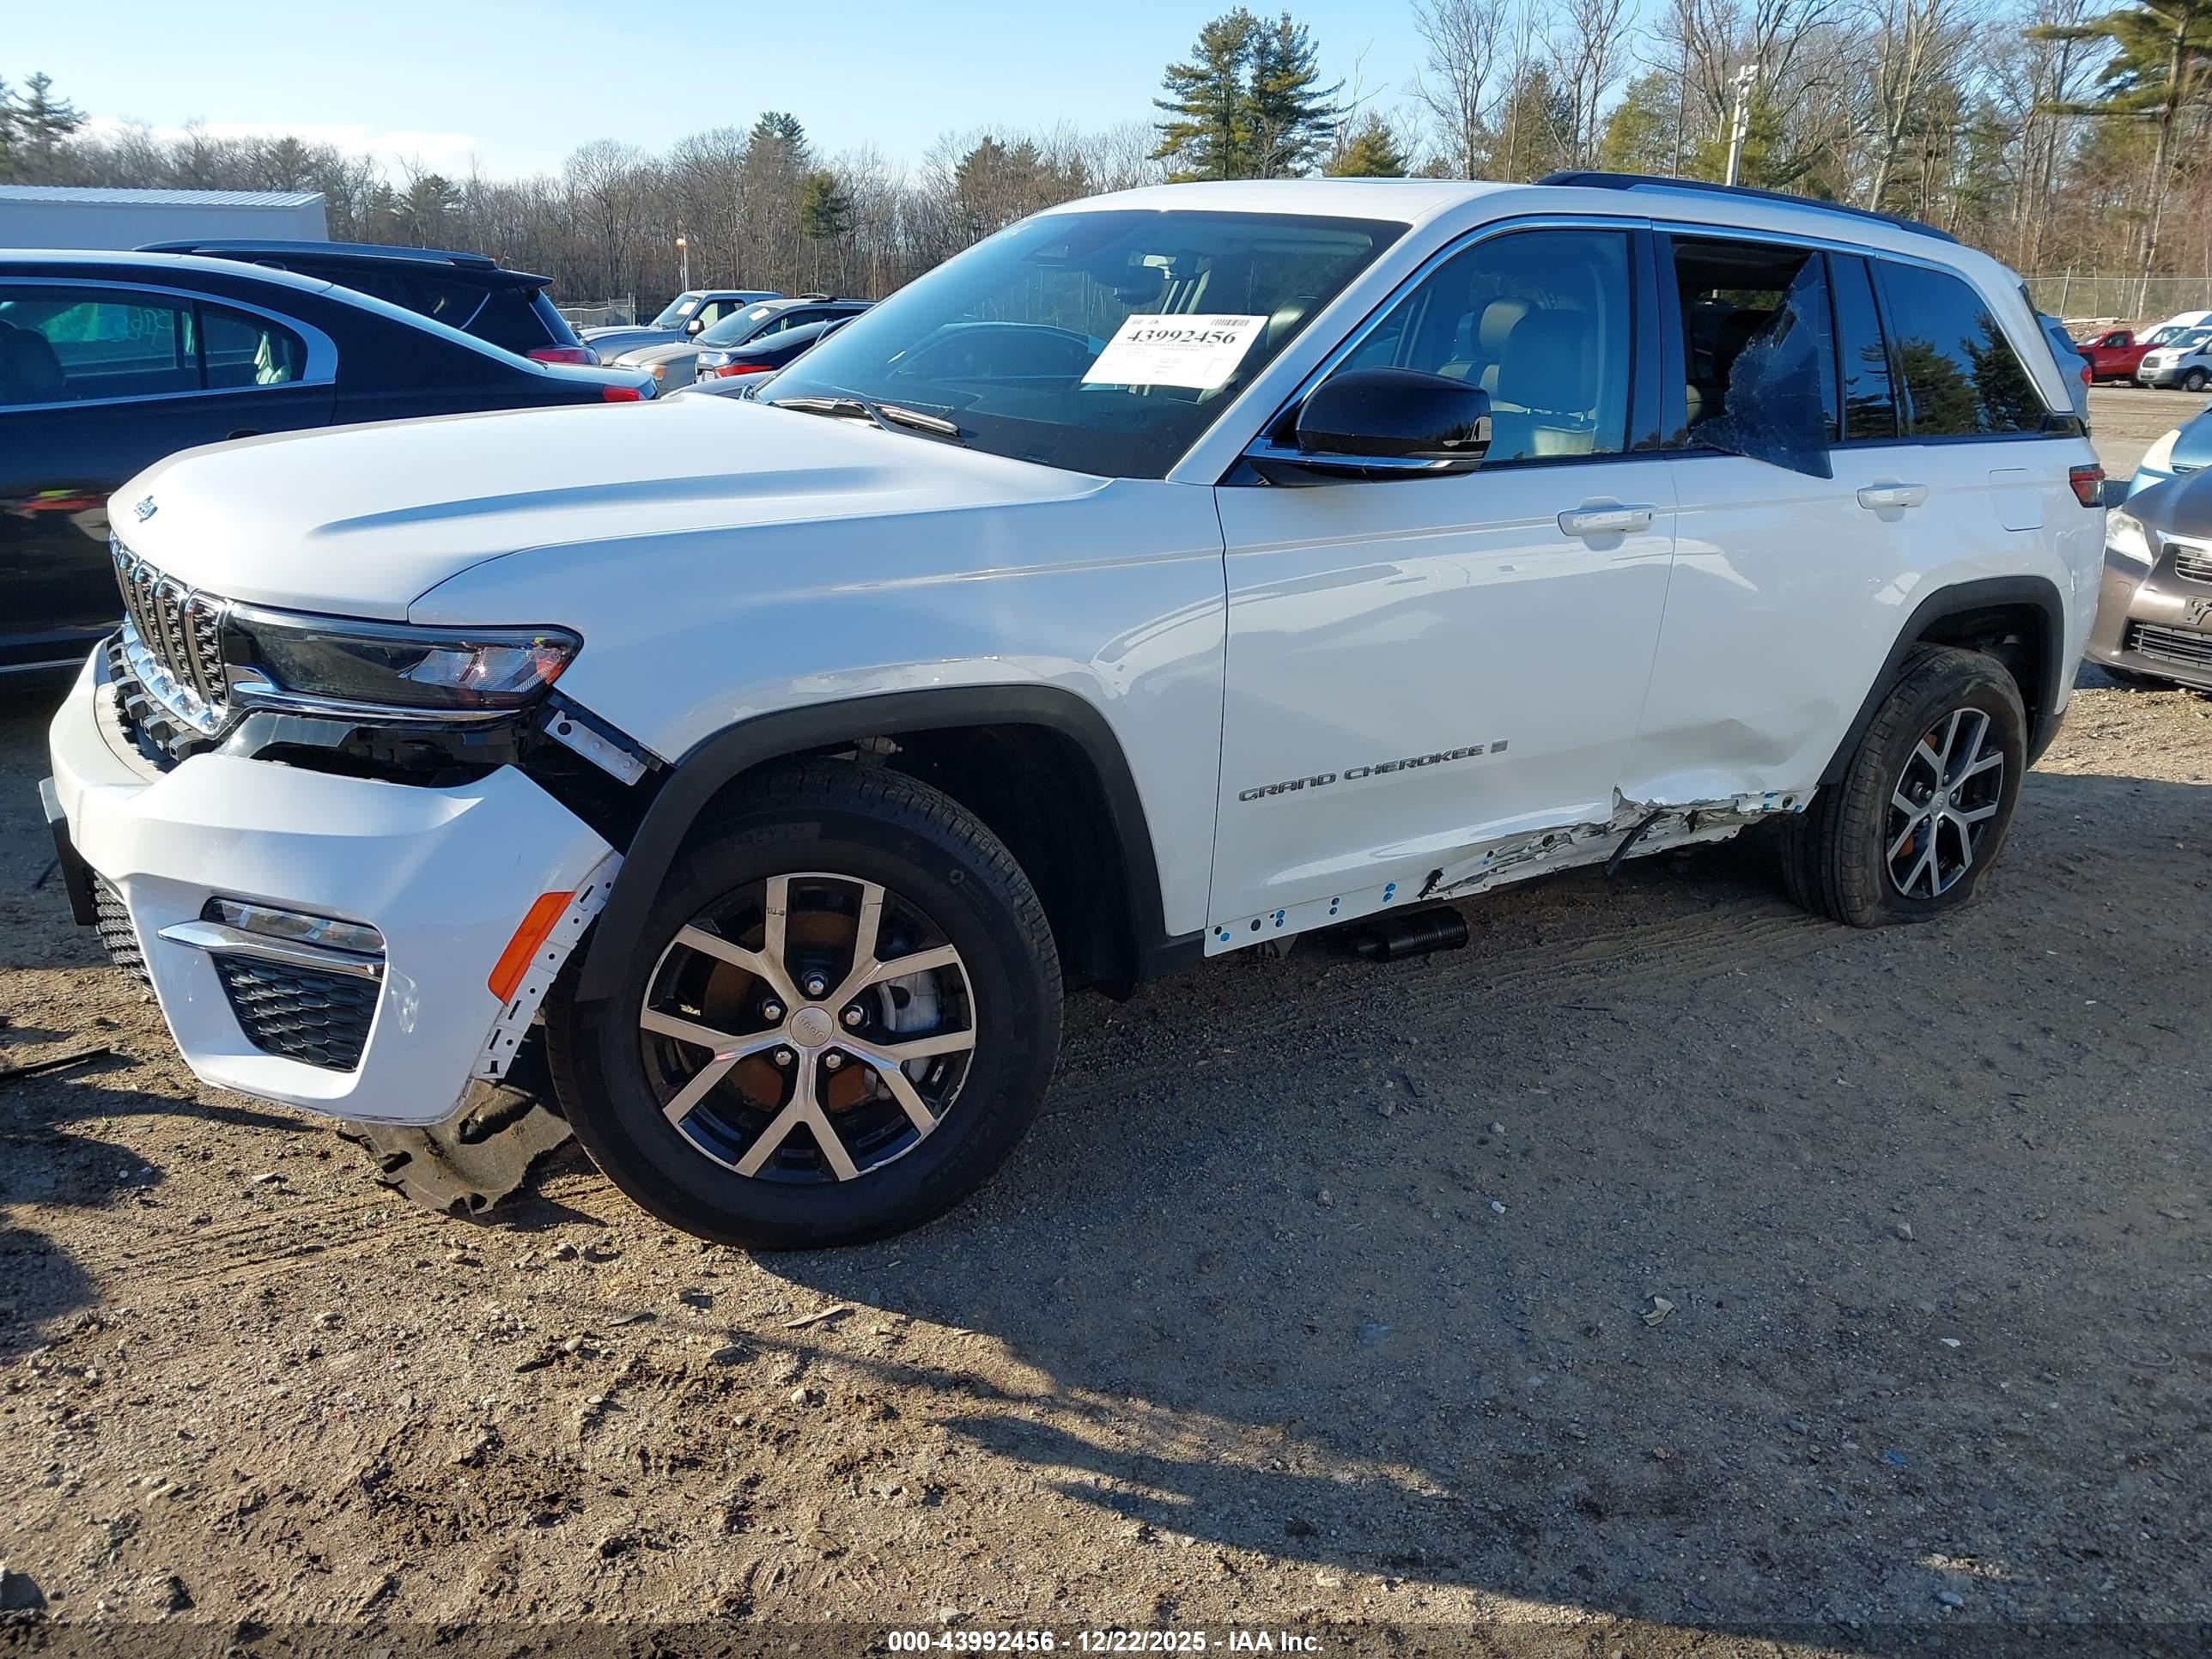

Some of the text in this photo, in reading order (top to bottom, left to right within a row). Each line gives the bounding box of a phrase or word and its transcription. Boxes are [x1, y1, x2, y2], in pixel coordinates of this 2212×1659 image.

[1127, 329, 1241, 344] 43992456
[1238, 744, 1485, 801] GRAND CHEROKEE
[798, 1016, 825, 1040] Jeep
